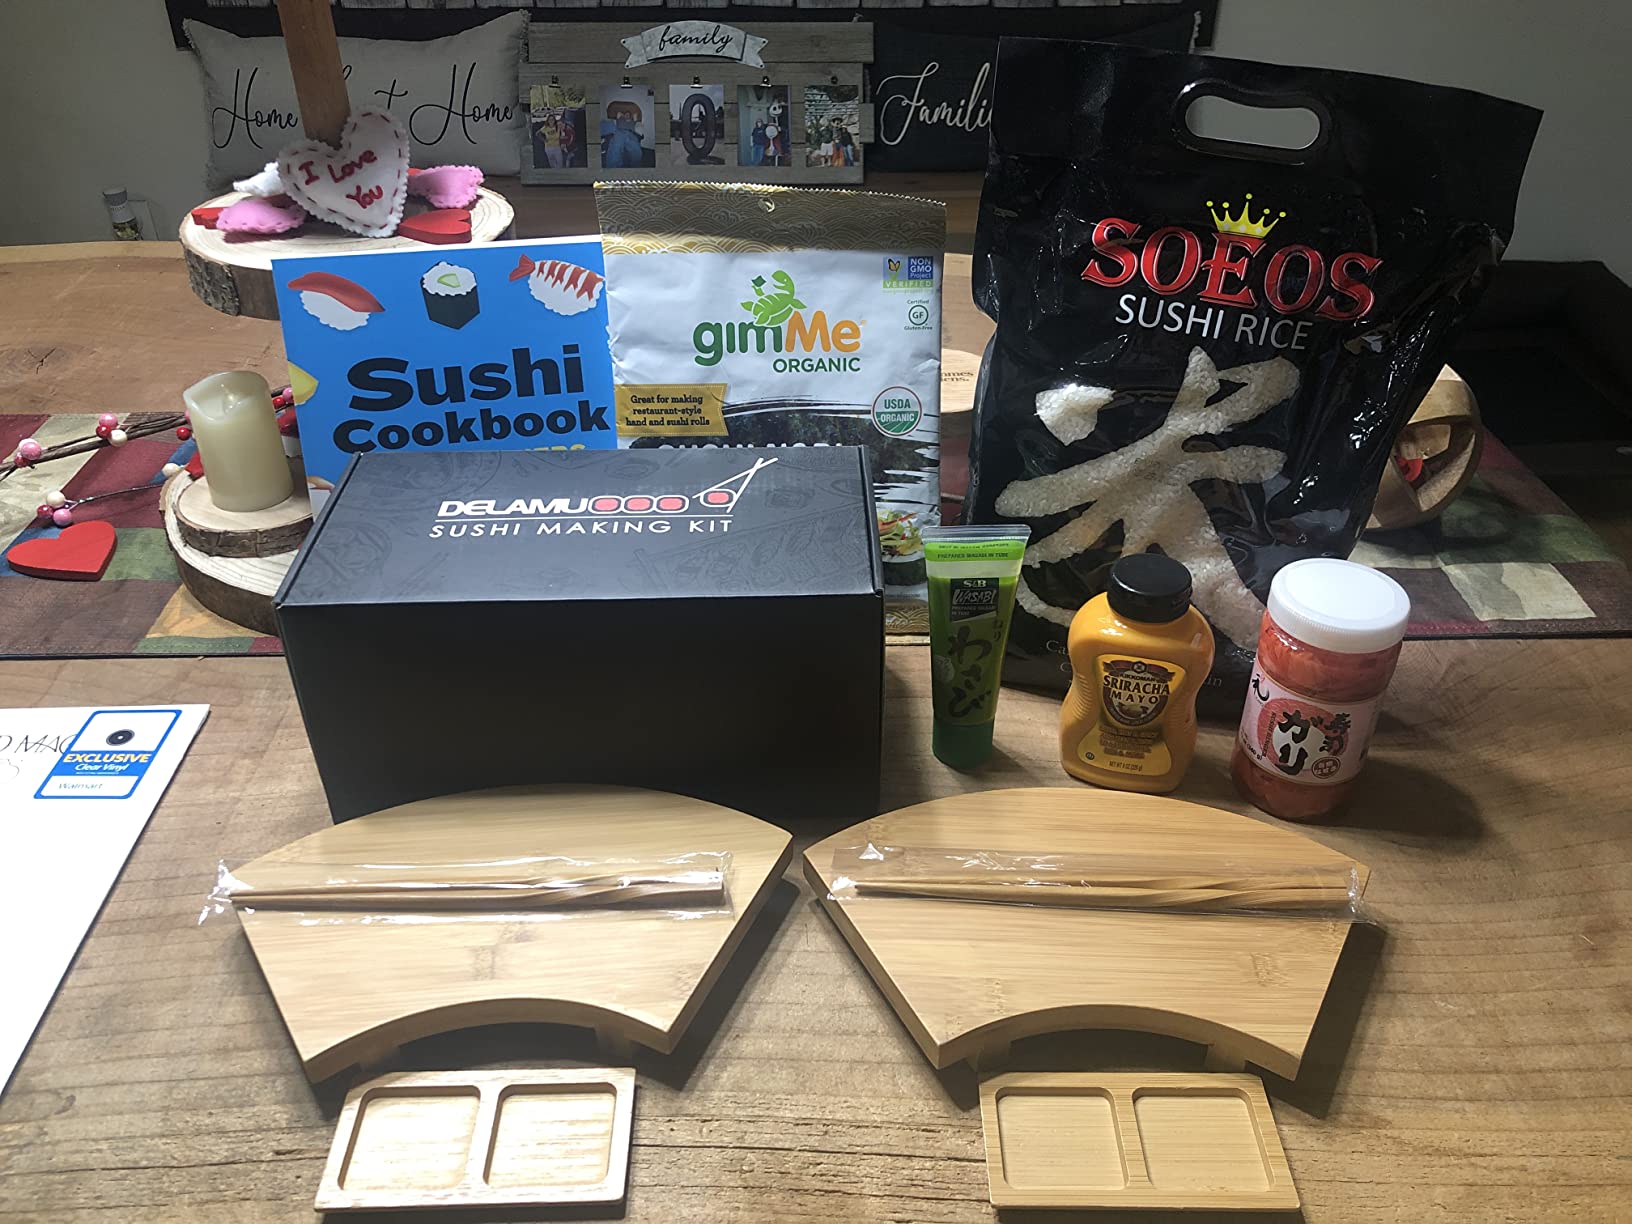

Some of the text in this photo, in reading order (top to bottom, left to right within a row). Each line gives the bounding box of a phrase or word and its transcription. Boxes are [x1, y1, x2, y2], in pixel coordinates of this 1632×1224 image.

[657, 25, 734, 53] family
[212, 61, 513, 150] Home Home
[875, 61, 993, 146] Famili
[299, 146, 377, 186] I Love
[345, 183, 384, 209] You
[910, 265, 932, 273] GMO
[1081, 217, 1385, 320] SOEOS
[912, 311, 924, 319] GF
[1115, 294, 1313, 350] SUSHI RICE
[772, 357, 862, 374] ORGANIC
[347, 343, 584, 411] Sushi
[630, 394, 703, 404] Great for making
[884, 399, 911, 409] USDA
[633, 406, 702, 416] restaurant-style
[880, 413, 915, 422] ORGANIC
[333, 400, 611, 453] Cookbook
[625, 417, 709, 426] hand and sushi rolls
[429, 519, 733, 538] SUSHI MAKING KIT
[952, 589, 997, 605] WASABI
[1103, 675, 1170, 695] SRIRACHA
[1111, 690, 1159, 704] MAYO
[63, 753, 152, 763] EXCLUSIVE
[75, 763, 130, 772] Clear Vinyl
